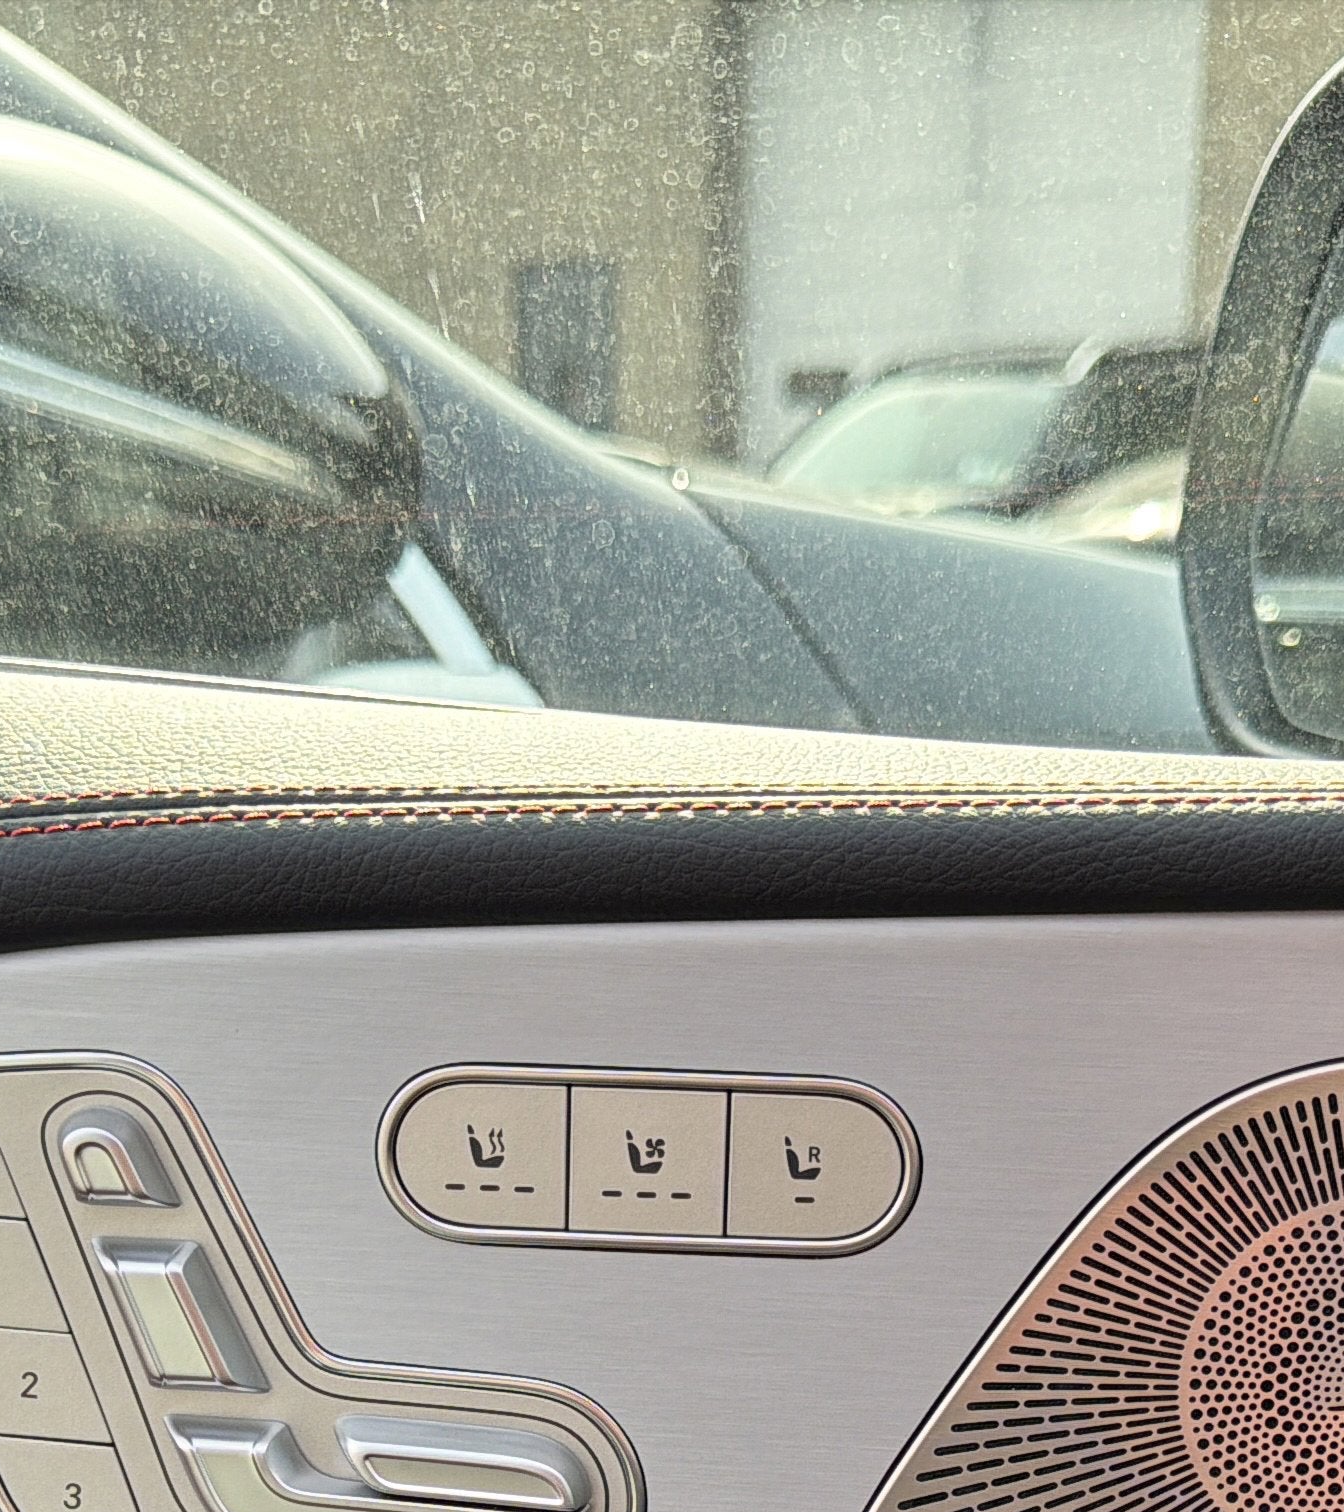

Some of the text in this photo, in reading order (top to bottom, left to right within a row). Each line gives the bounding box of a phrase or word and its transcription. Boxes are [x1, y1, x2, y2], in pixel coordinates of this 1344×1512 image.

[809, 1146, 820, 1163] R
[20, 1371, 39, 1399] 2
[63, 1482, 82, 1510] 3
